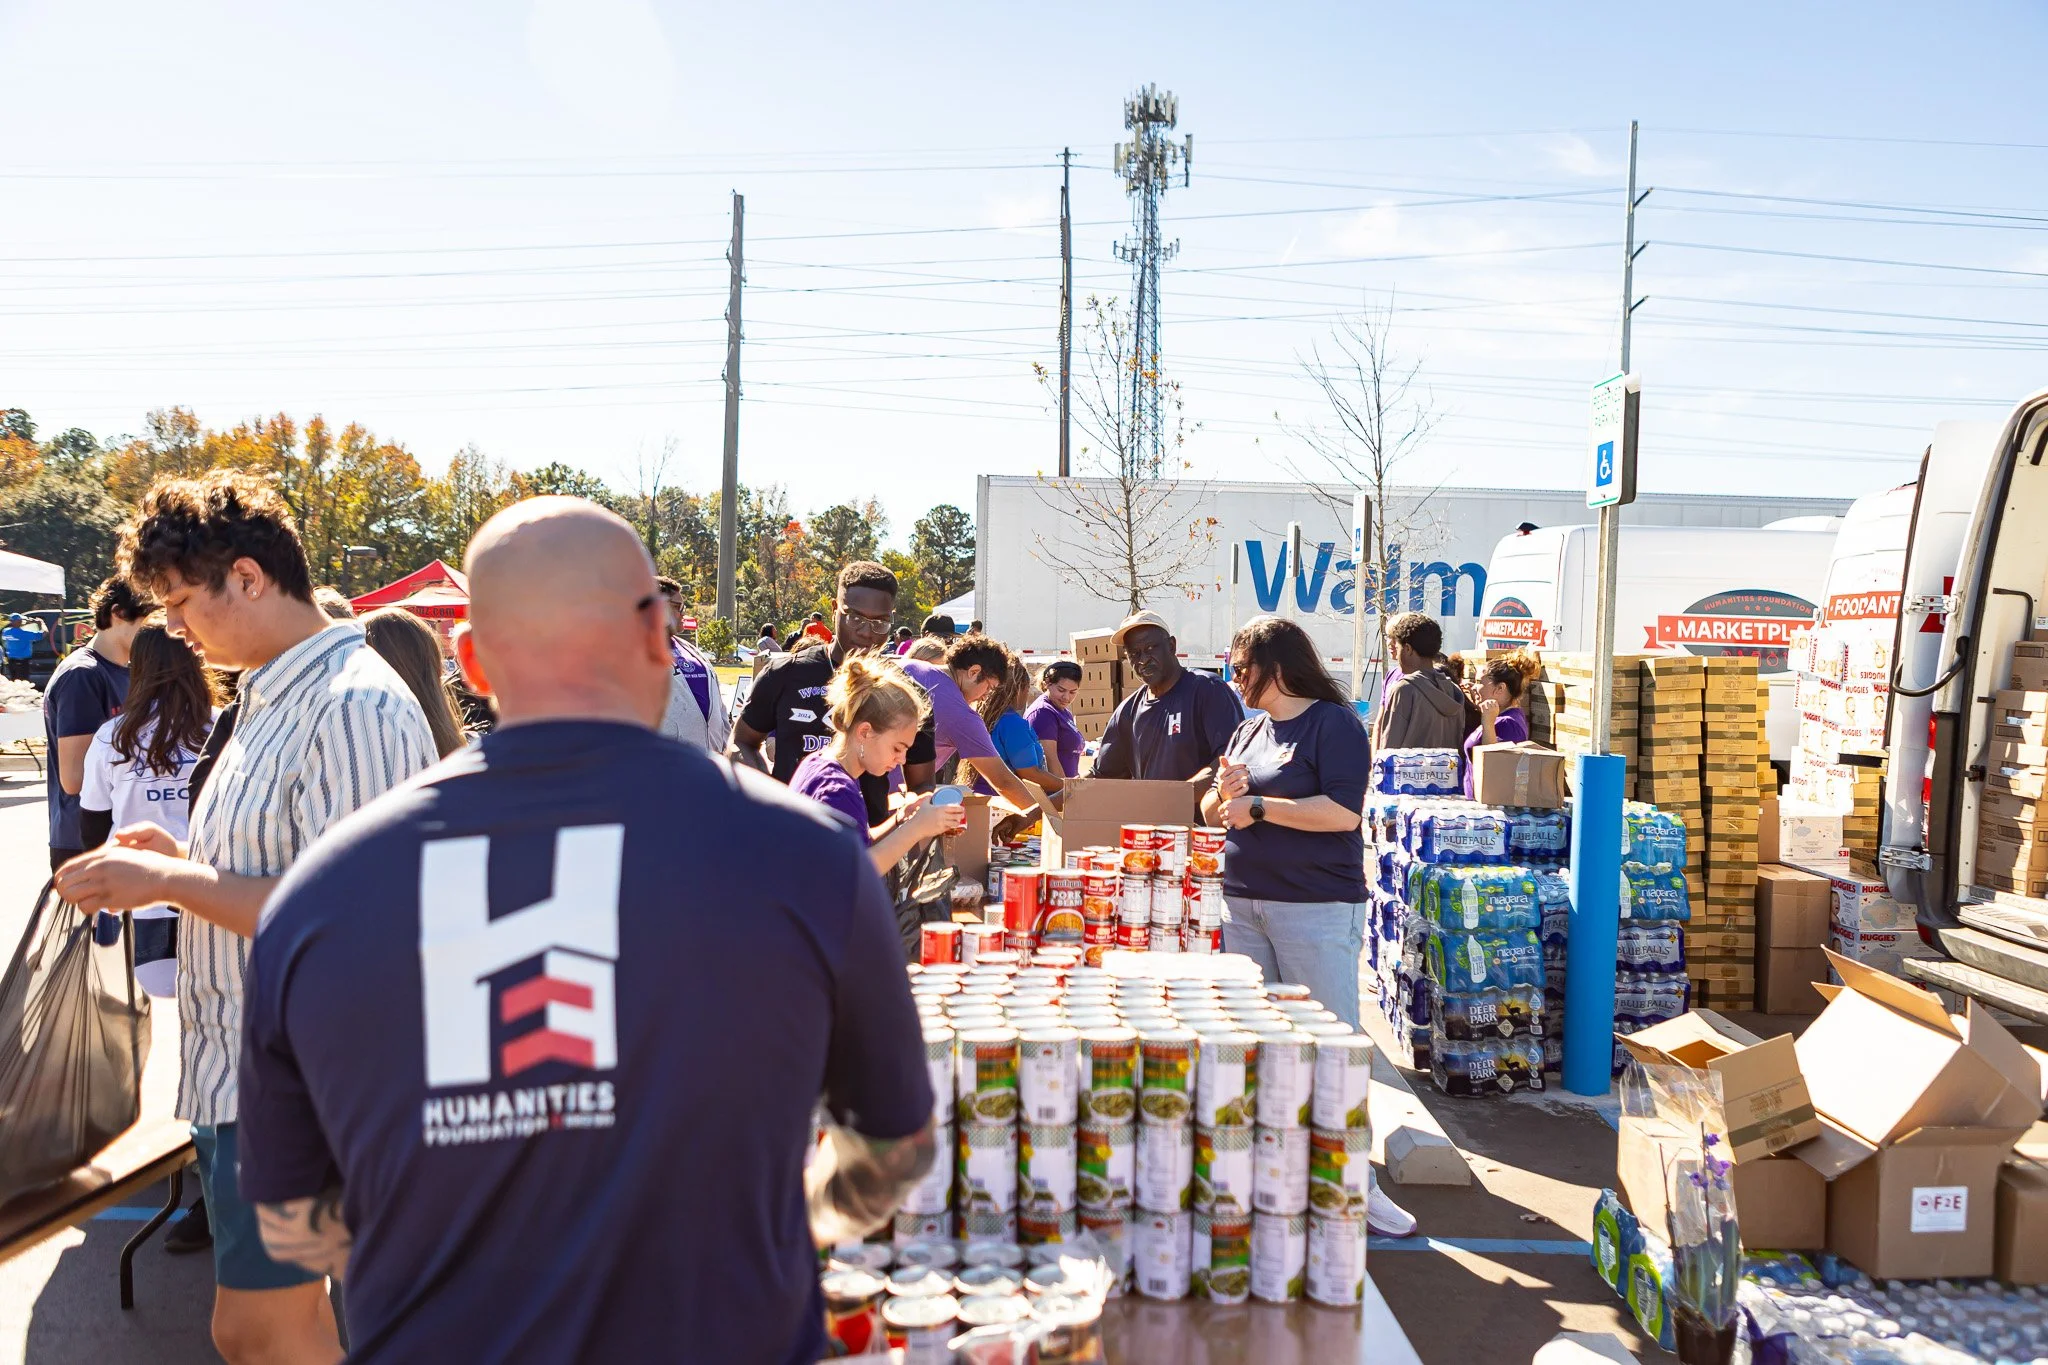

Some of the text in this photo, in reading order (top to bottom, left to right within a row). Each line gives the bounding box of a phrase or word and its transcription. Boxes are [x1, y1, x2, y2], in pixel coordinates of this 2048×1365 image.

[1704, 596, 1812, 615] HUMANITIES FOUNDATION
[1486, 621, 1534, 637] MARKETPLACE
[1820, 678, 1842, 690] HUGGIES
[1845, 686, 1869, 694] HUGGIES
[1841, 729, 1862, 737] HUGGIES
[1402, 770, 1450, 781] BLUE FALLS
[1531, 830, 1558, 841] FALLS
[1641, 825, 1678, 836] niagara
[1443, 835, 1496, 846] BLUE FALLS
[1052, 890, 1082, 899] PORK
[1641, 888, 1678, 899] niagara
[1489, 894, 1529, 906] niagara
[1860, 933, 1896, 942] HUGGIES
[1496, 945, 1536, 957] niagara
[1617, 946, 1671, 956] BLUE FALLS
[1469, 1004, 1497, 1015] DEER
[1620, 999, 1677, 1009] BLUE FALLS
[1470, 1013, 1498, 1024] PARK
[1469, 1059, 1496, 1070] DEER
[1469, 1068, 1497, 1080] PARK
[423, 1081, 616, 1127] HUMANITIES
[423, 1115, 550, 1148] FOUNDATION
